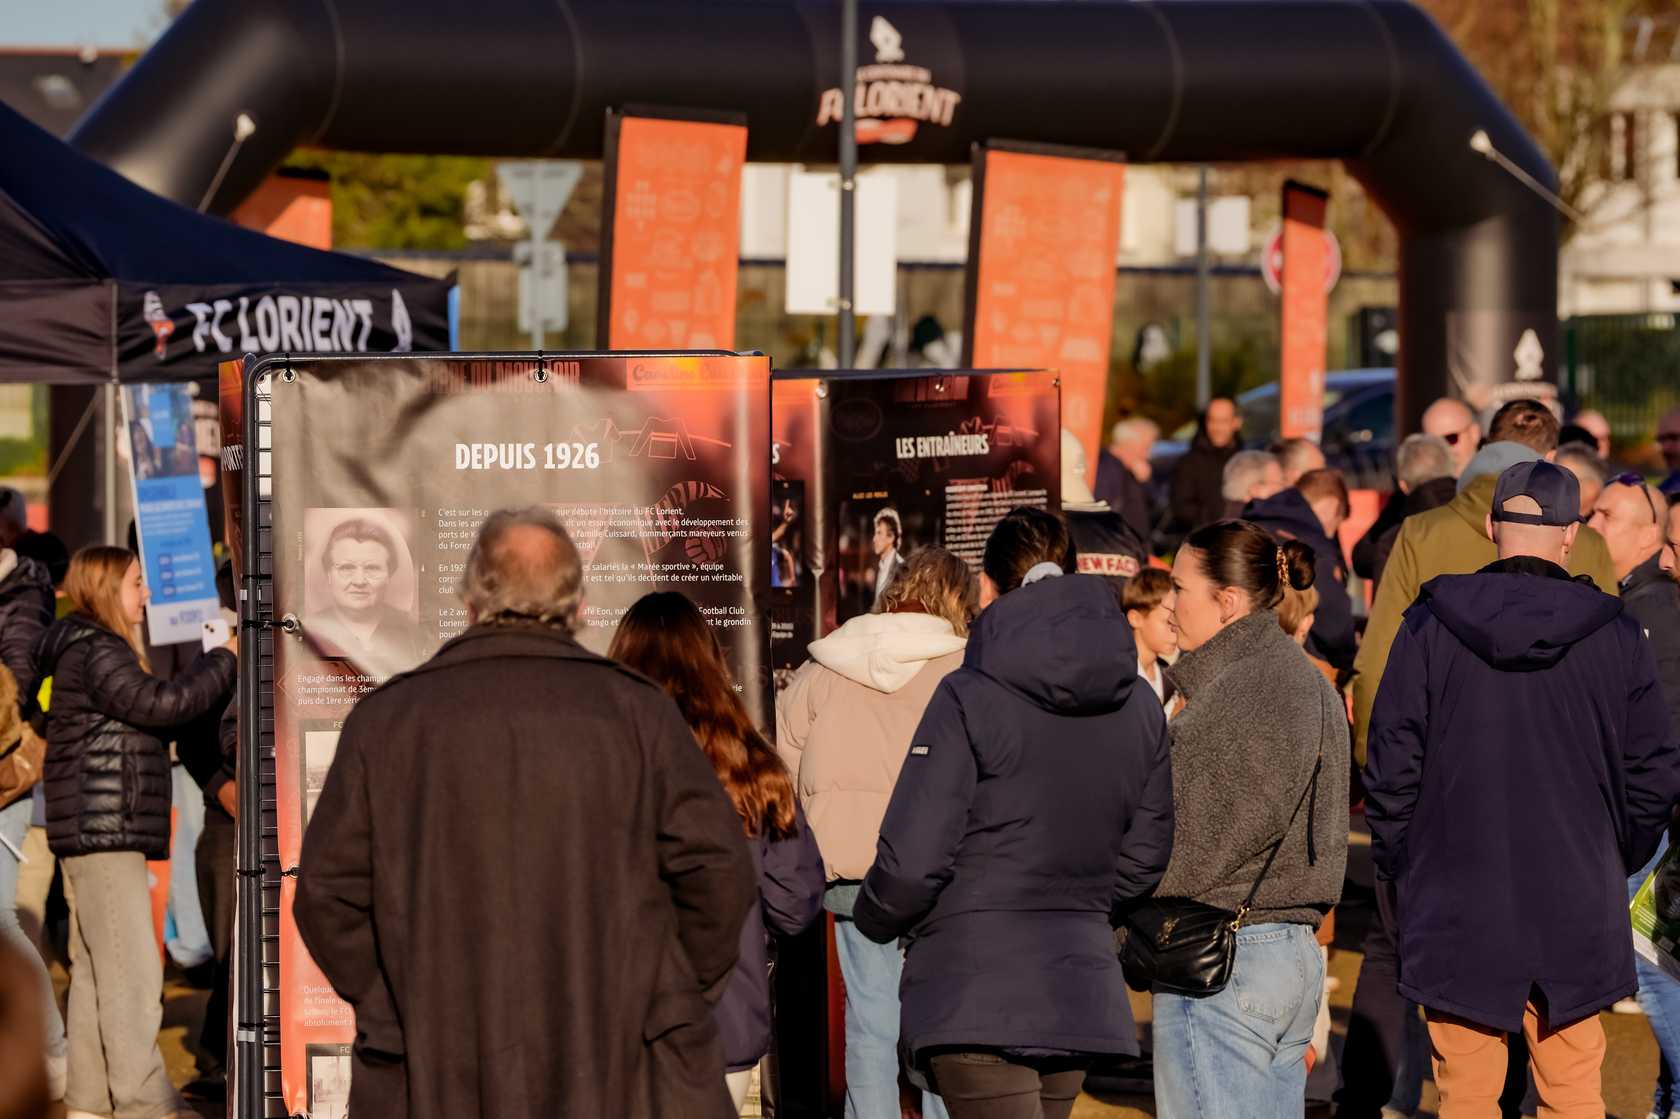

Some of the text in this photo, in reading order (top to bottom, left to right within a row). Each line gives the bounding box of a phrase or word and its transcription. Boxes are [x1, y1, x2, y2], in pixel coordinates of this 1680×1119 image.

[185, 295, 374, 352] FC LORIENT
[895, 430, 990, 458] LES ENTRAÎNEURS
[455, 442, 600, 470] DEPUIS 1926
[458, 508, 471, 517] sur
[472, 508, 482, 517] les
[634, 507, 643, 517] du
[645, 507, 655, 517] FC
[657, 507, 684, 517] Lorient.
[438, 519, 457, 528] Dans
[458, 519, 469, 528] les
[609, 518, 653, 528] économique
[655, 518, 672, 528] avec
[673, 518, 680, 528] le
[681, 518, 735, 528] développement
[736, 518, 749, 528] des
[438, 531, 458, 540] ports
[460, 531, 469, 540] de
[604, 530, 638, 539] Cuissard,
[639, 530, 688, 539] commerçants
[689, 530, 726, 539] mareyeurs
[727, 530, 749, 539] venus
[438, 541, 448, 550] du
[439, 564, 448, 573] En
[637, 563, 660, 572] Marée
[661, 563, 690, 572] sportive
[700, 563, 724, 572] équipe
[591, 574, 602, 582] est
[604, 574, 616, 582] tel
[637, 574, 669, 582] décident
[670, 574, 680, 582] de
[681, 574, 699, 582] créer
[700, 574, 710, 582] un
[711, 574, 743, 582] véritable
[439, 586, 454, 594] club
[439, 607, 448, 616] Le
[449, 607, 455, 616] 2
[699, 606, 745, 615] Football Club
[587, 618, 620, 628] tango et
[715, 618, 723, 627] le
[723, 618, 752, 627] grondin
[439, 631, 456, 639] pour
[326, 673, 344, 684] dans
[345, 673, 356, 684] les
[298, 684, 346, 694] championnat
[348, 684, 358, 694] de
[298, 696, 315, 706] puis
[315, 696, 324, 706] de
